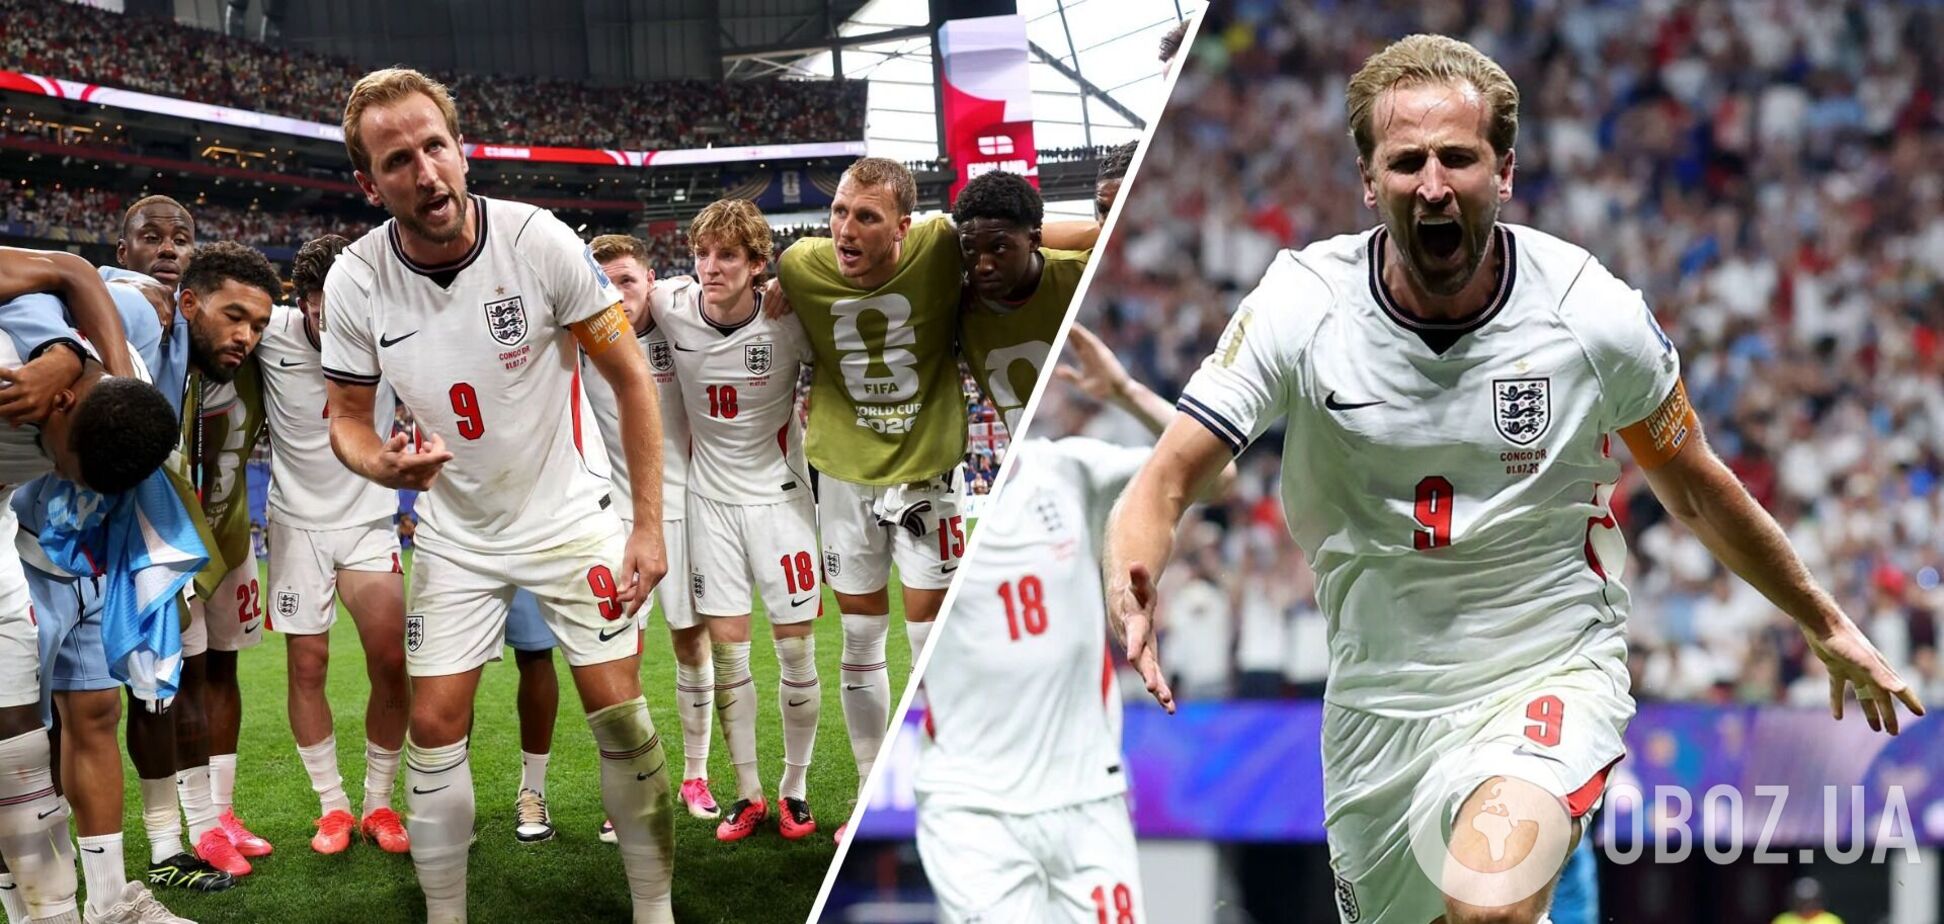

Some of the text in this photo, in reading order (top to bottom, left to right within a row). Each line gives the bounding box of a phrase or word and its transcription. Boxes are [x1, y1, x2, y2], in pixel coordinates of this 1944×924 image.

[499, 349, 521, 361] CONGO
[705, 384, 739, 420] 18
[864, 382, 899, 395] FIFA
[896, 403, 922, 415] CUP
[448, 382, 485, 441] 9
[1649, 394, 1684, 439] UNITES
[1500, 448, 1548, 462] CONGO DR
[1413, 475, 1454, 551] 9
[938, 514, 965, 561] 15
[586, 564, 623, 622] 9
[779, 550, 815, 594] 18
[236, 578, 262, 623] 22
[996, 574, 1050, 642] 18
[1523, 694, 1565, 747] 9
[1091, 883, 1135, 924] 18
